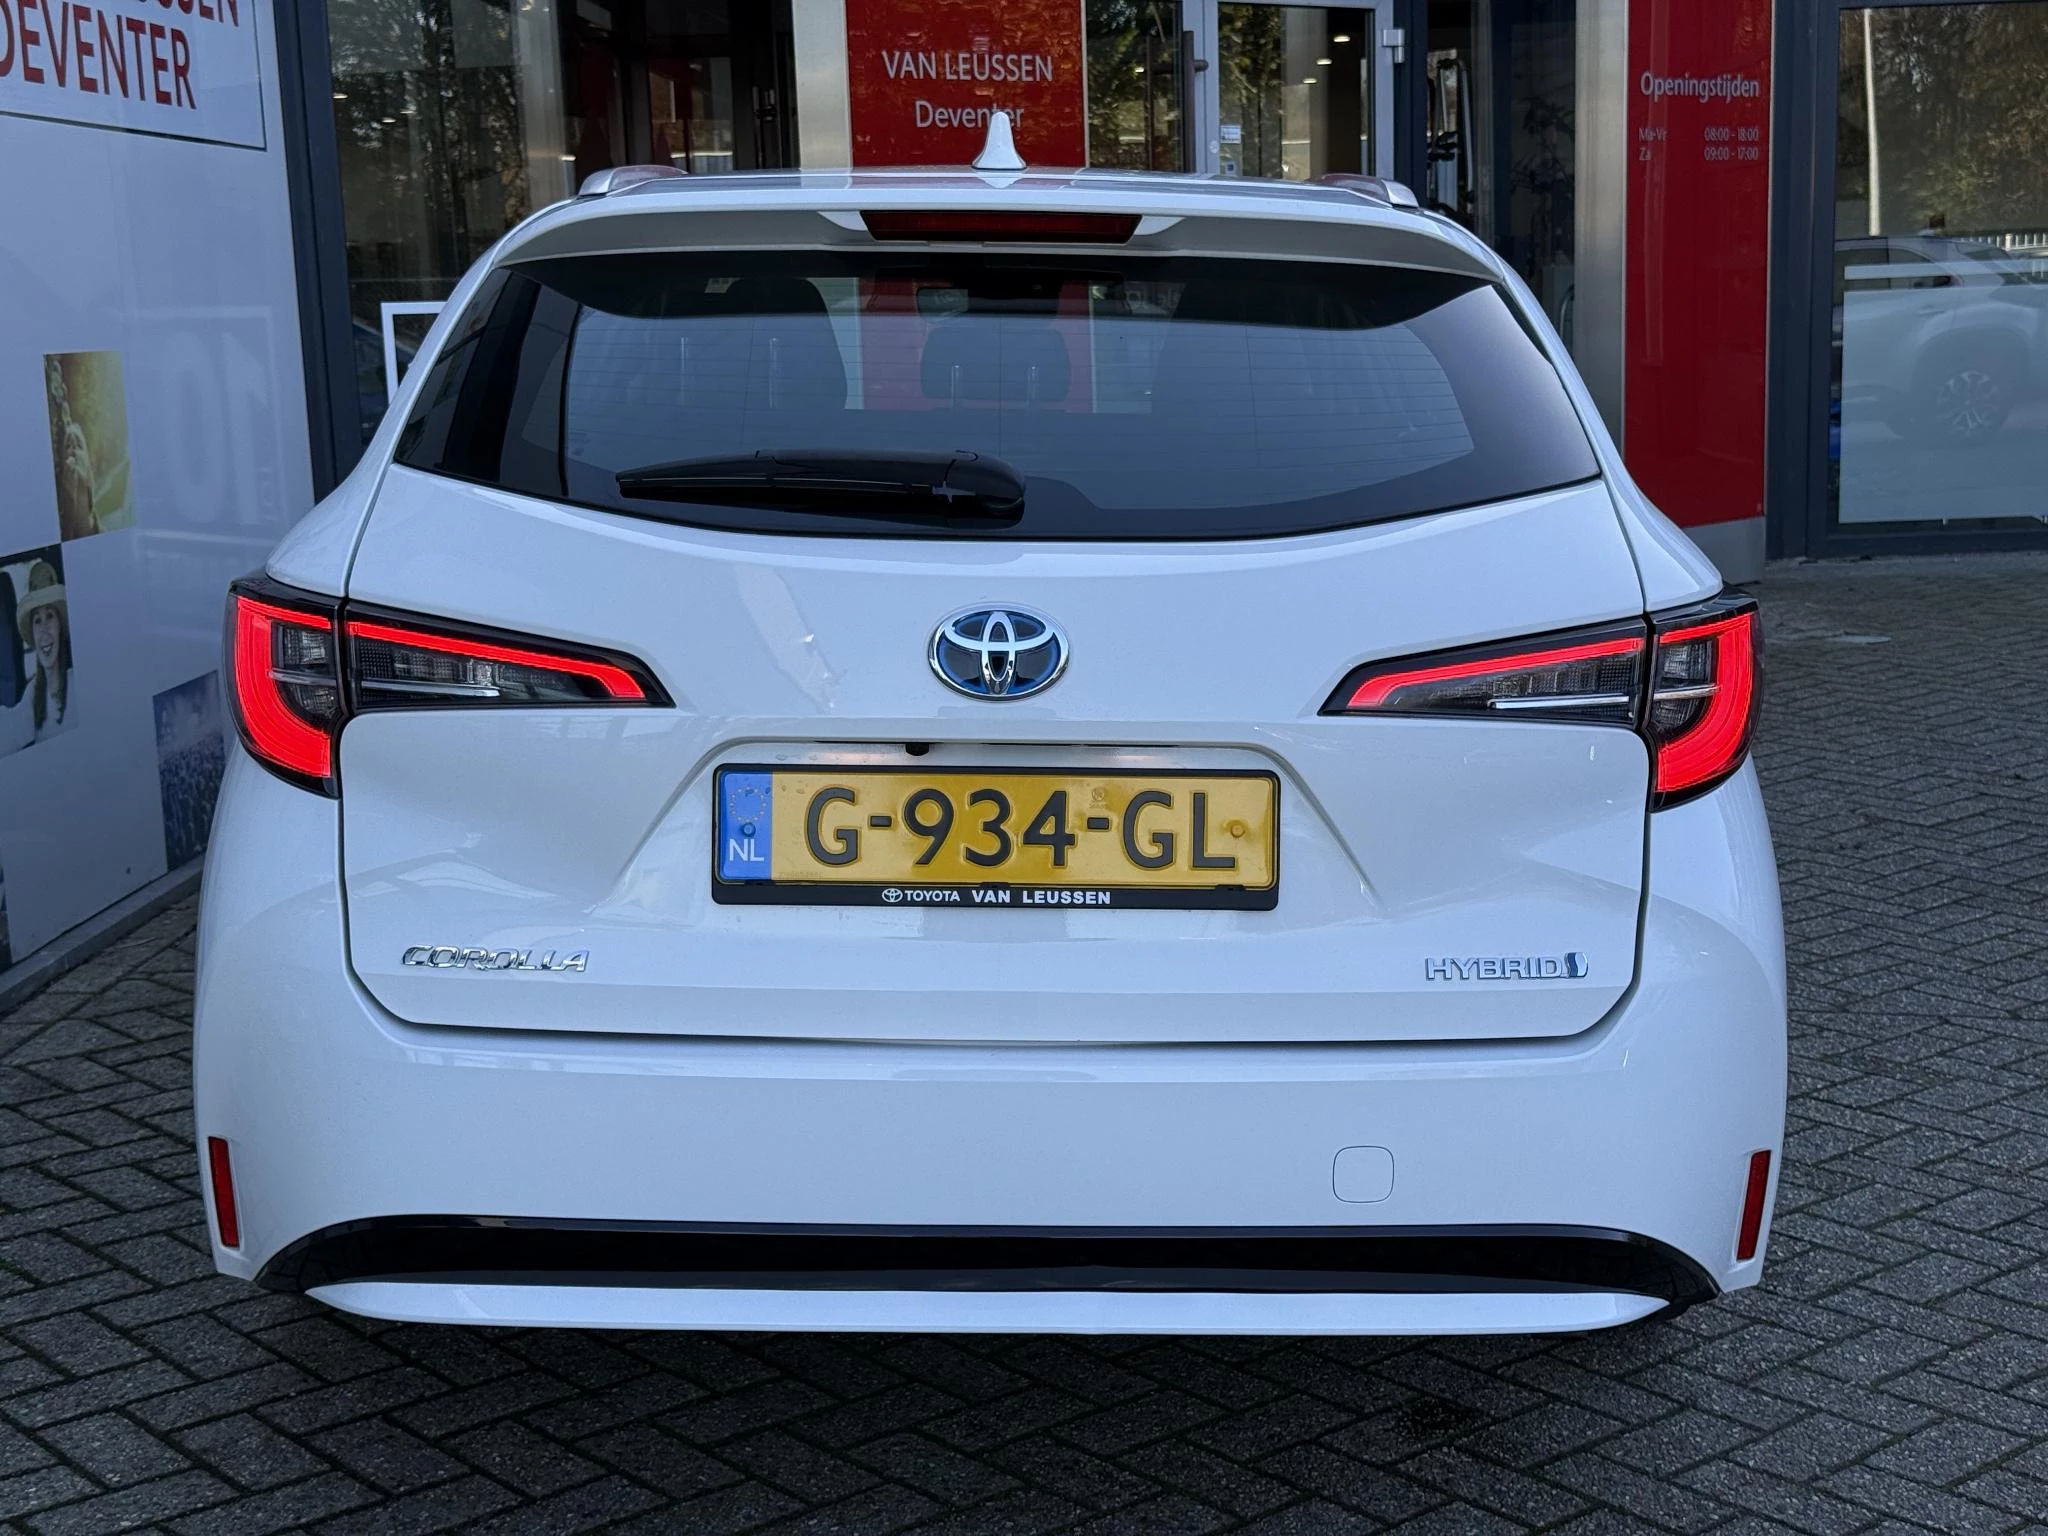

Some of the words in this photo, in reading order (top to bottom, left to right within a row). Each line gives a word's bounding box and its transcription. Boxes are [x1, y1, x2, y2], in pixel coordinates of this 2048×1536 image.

[882, 51, 937, 80] VAN
[944, 52, 1053, 82] LEUSSEN
[1640, 71, 1760, 104] Openingstijden
[1704, 126, 1729, 141] 08:00
[1738, 126, 1759, 141] 18:00
[1639, 146, 1651, 161] Za
[1704, 146, 1729, 161] 09:00
[1737, 147, 1759, 161] 17:00
[807, 786, 1237, 869] G-934-GL
[728, 838, 765, 862] NL
[904, 889, 961, 902] TOYOTA
[971, 889, 1011, 904] VAN
[1022, 890, 1111, 905] LEUSSEN
[401, 945, 590, 973] COROLLA
[1425, 956, 1563, 981] HYBRID
